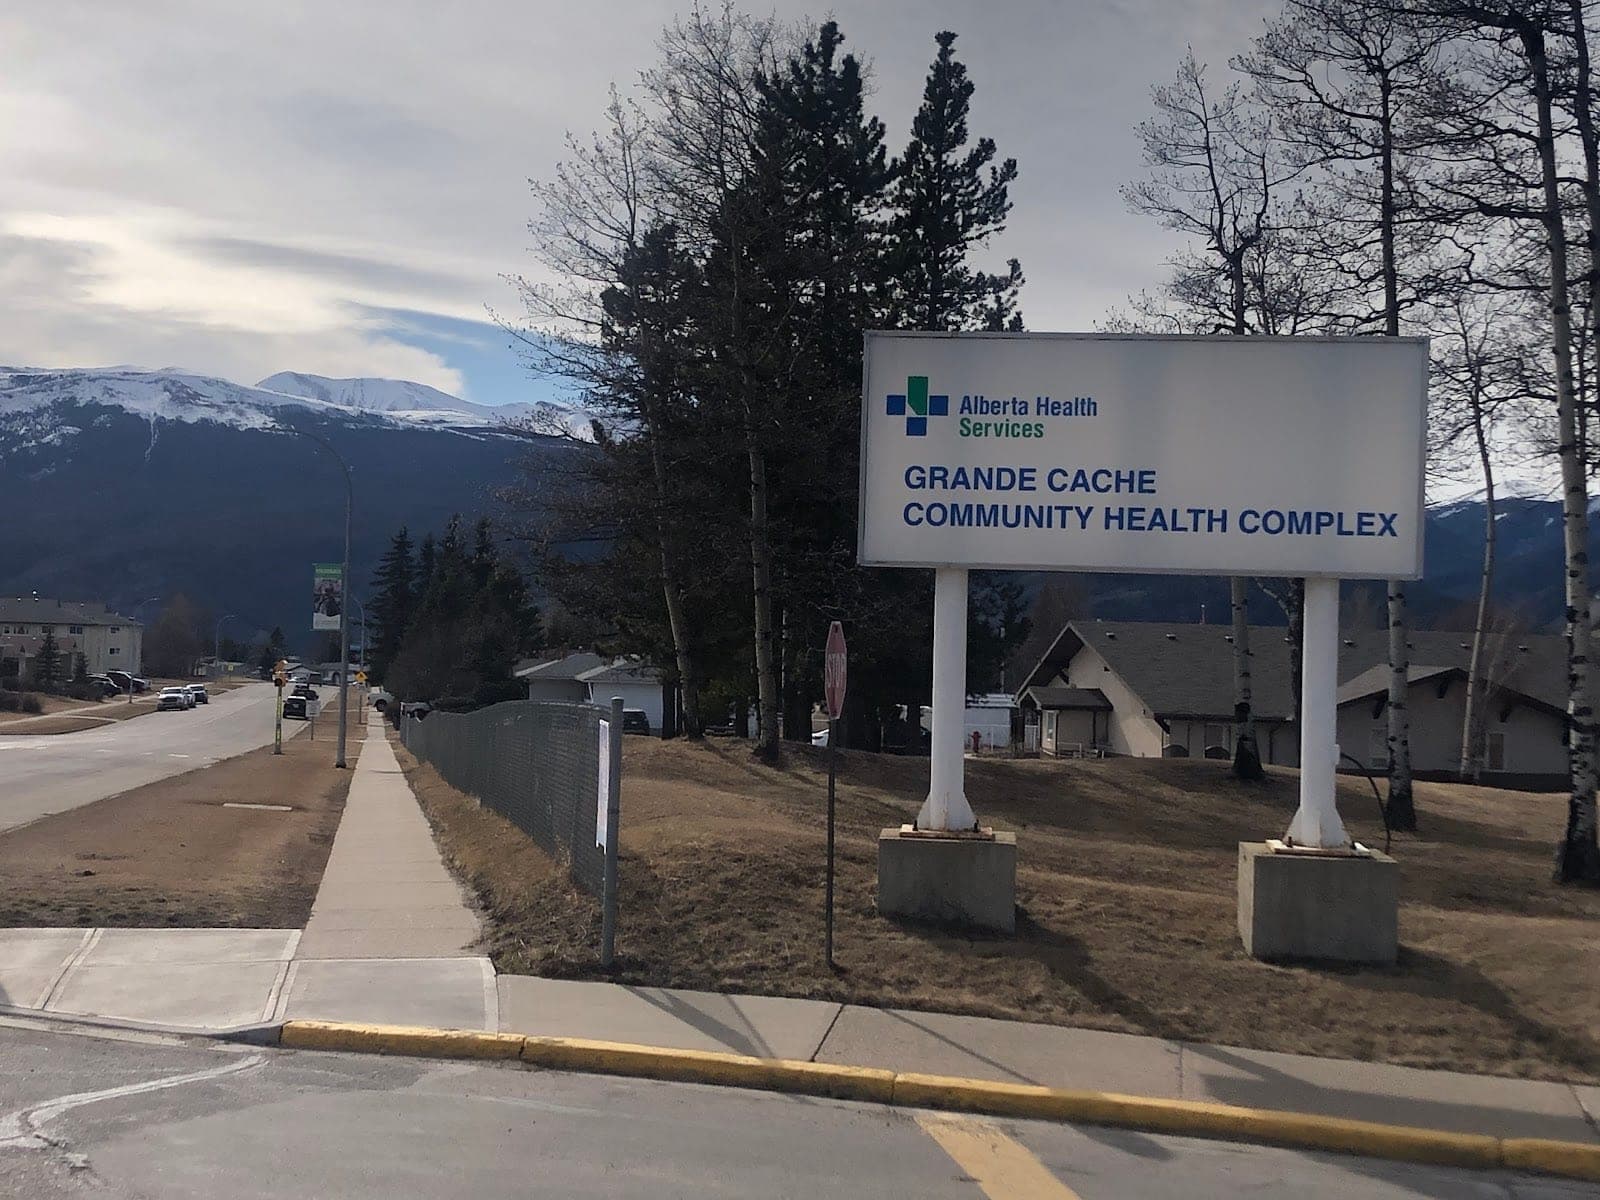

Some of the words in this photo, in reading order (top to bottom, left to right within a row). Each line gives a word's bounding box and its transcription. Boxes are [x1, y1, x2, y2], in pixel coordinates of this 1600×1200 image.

[959, 395, 1029, 416] Alberta
[1036, 396, 1098, 417] Health
[959, 417, 1045, 439] Services
[904, 465, 1037, 492] GRANDE
[1047, 468, 1157, 494] CACHE
[903, 502, 1094, 530] COMMUNITY
[1104, 506, 1228, 533] HEALTH
[1238, 509, 1398, 537] COMPLEX
[826, 653, 846, 688] STOP
